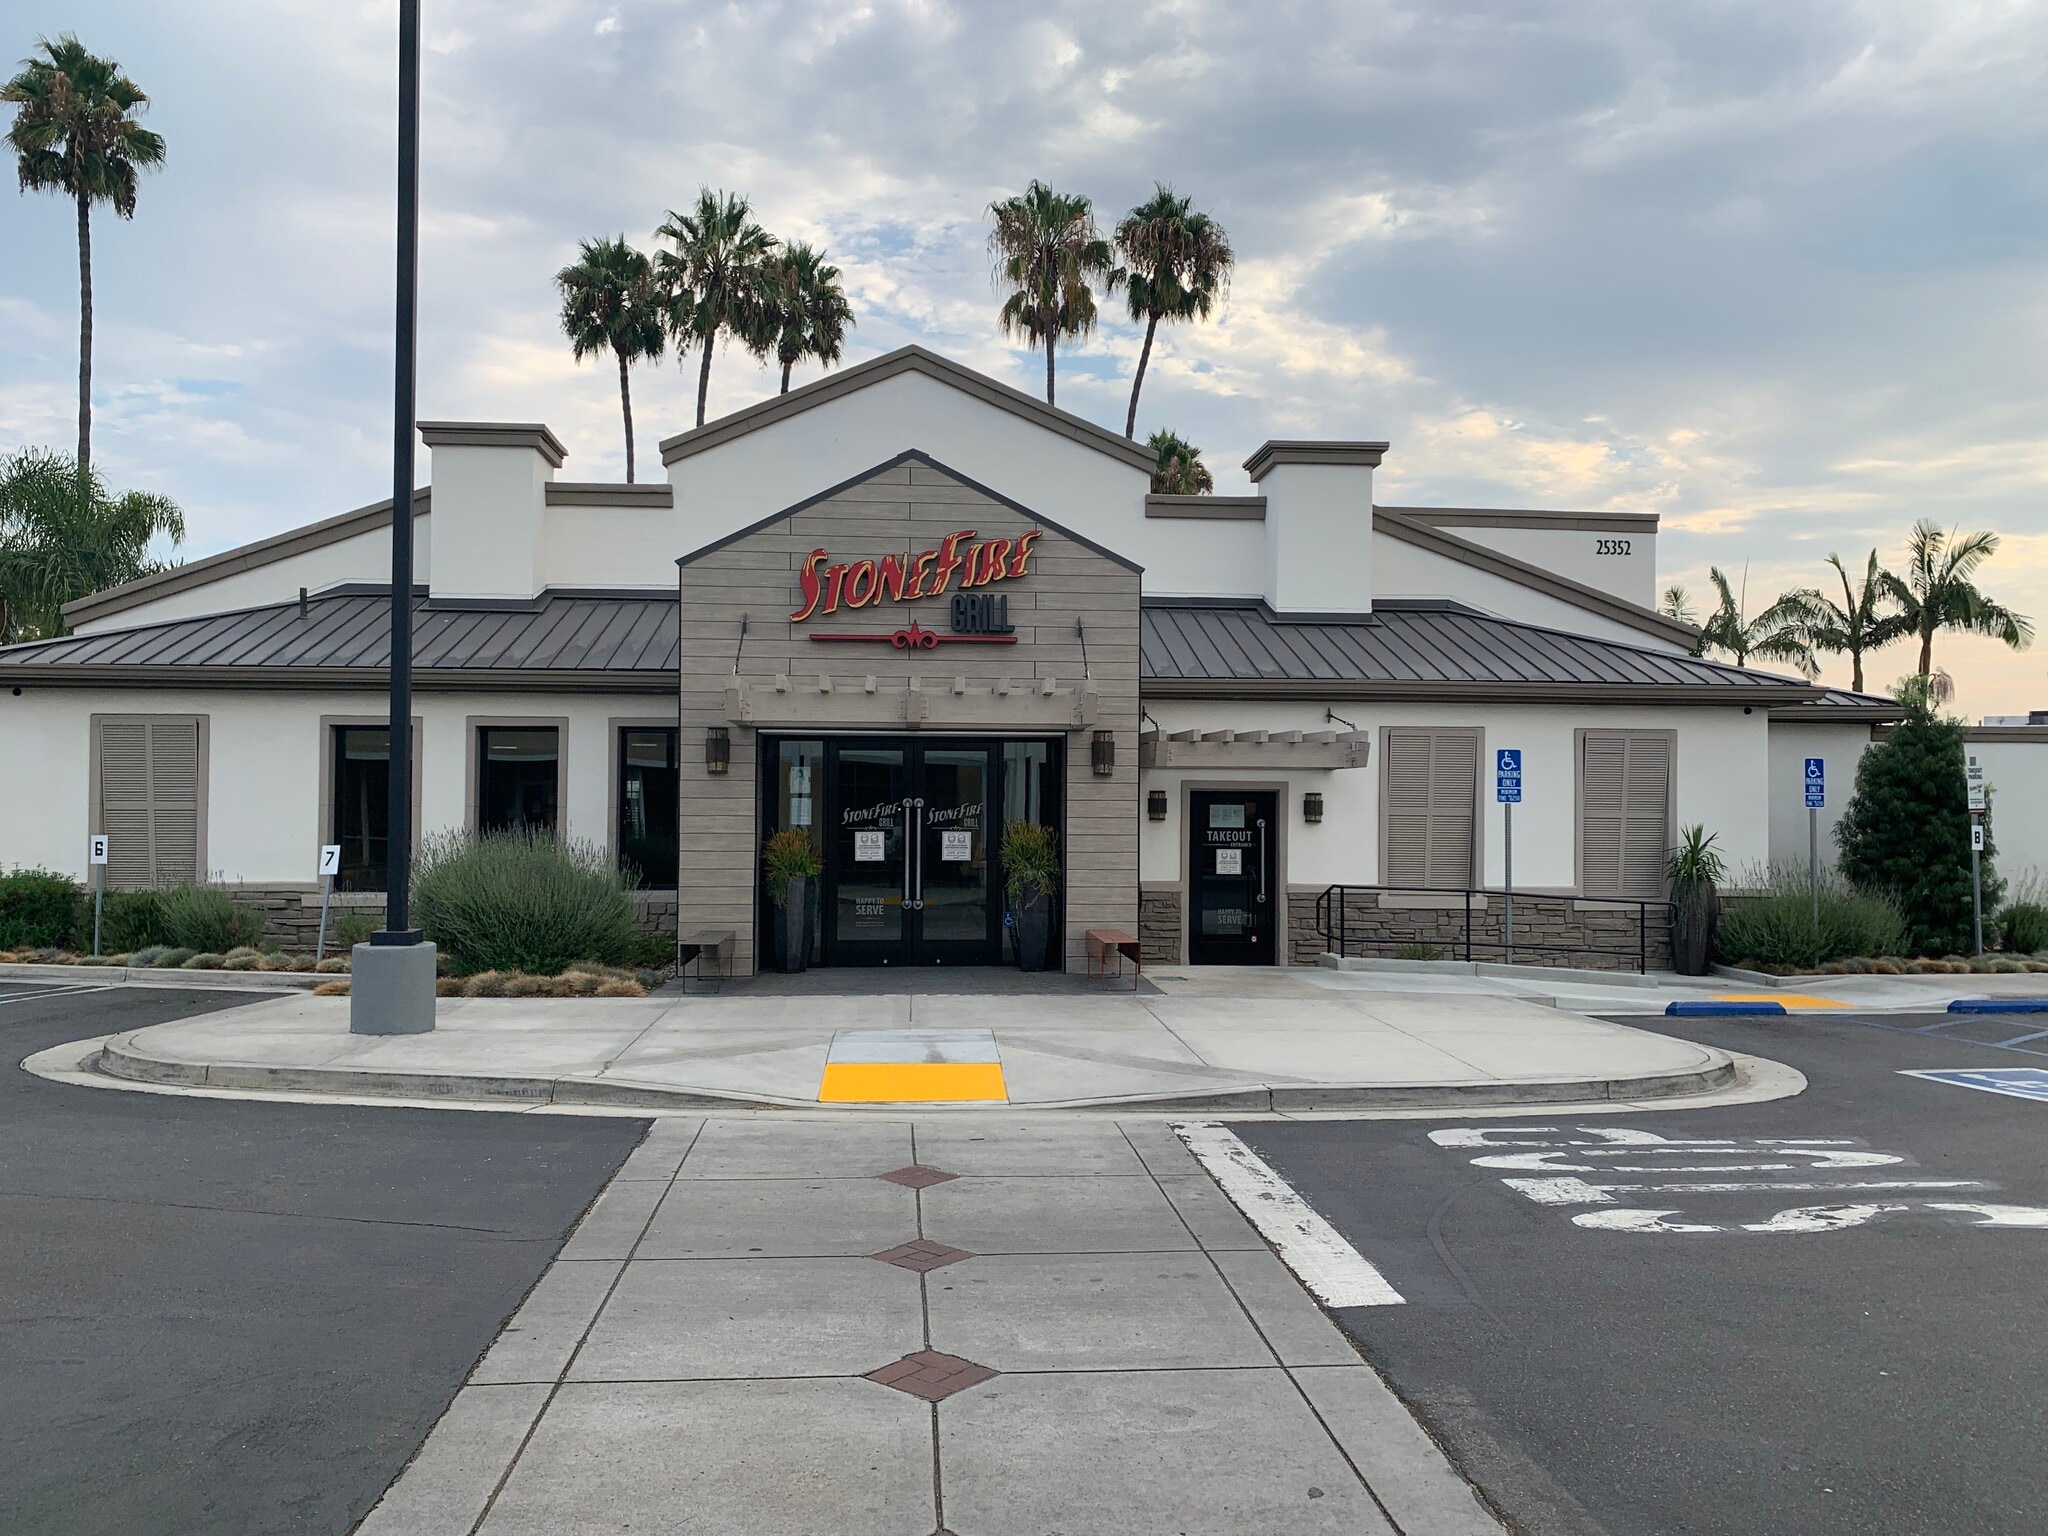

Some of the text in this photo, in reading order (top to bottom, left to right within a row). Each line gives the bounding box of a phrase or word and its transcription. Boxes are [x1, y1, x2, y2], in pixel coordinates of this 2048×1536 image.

[1596, 539, 1631, 555] 25352
[951, 594, 1015, 633] GRILL
[879, 818, 894, 827] GRILL
[963, 818, 979, 828] GRILL
[1206, 830, 1253, 842] TAKEOUT
[95, 841, 104, 857] 6
[325, 851, 335, 867] 7
[855, 905, 885, 915] SERVE
[1217, 915, 1242, 924] SERVE
